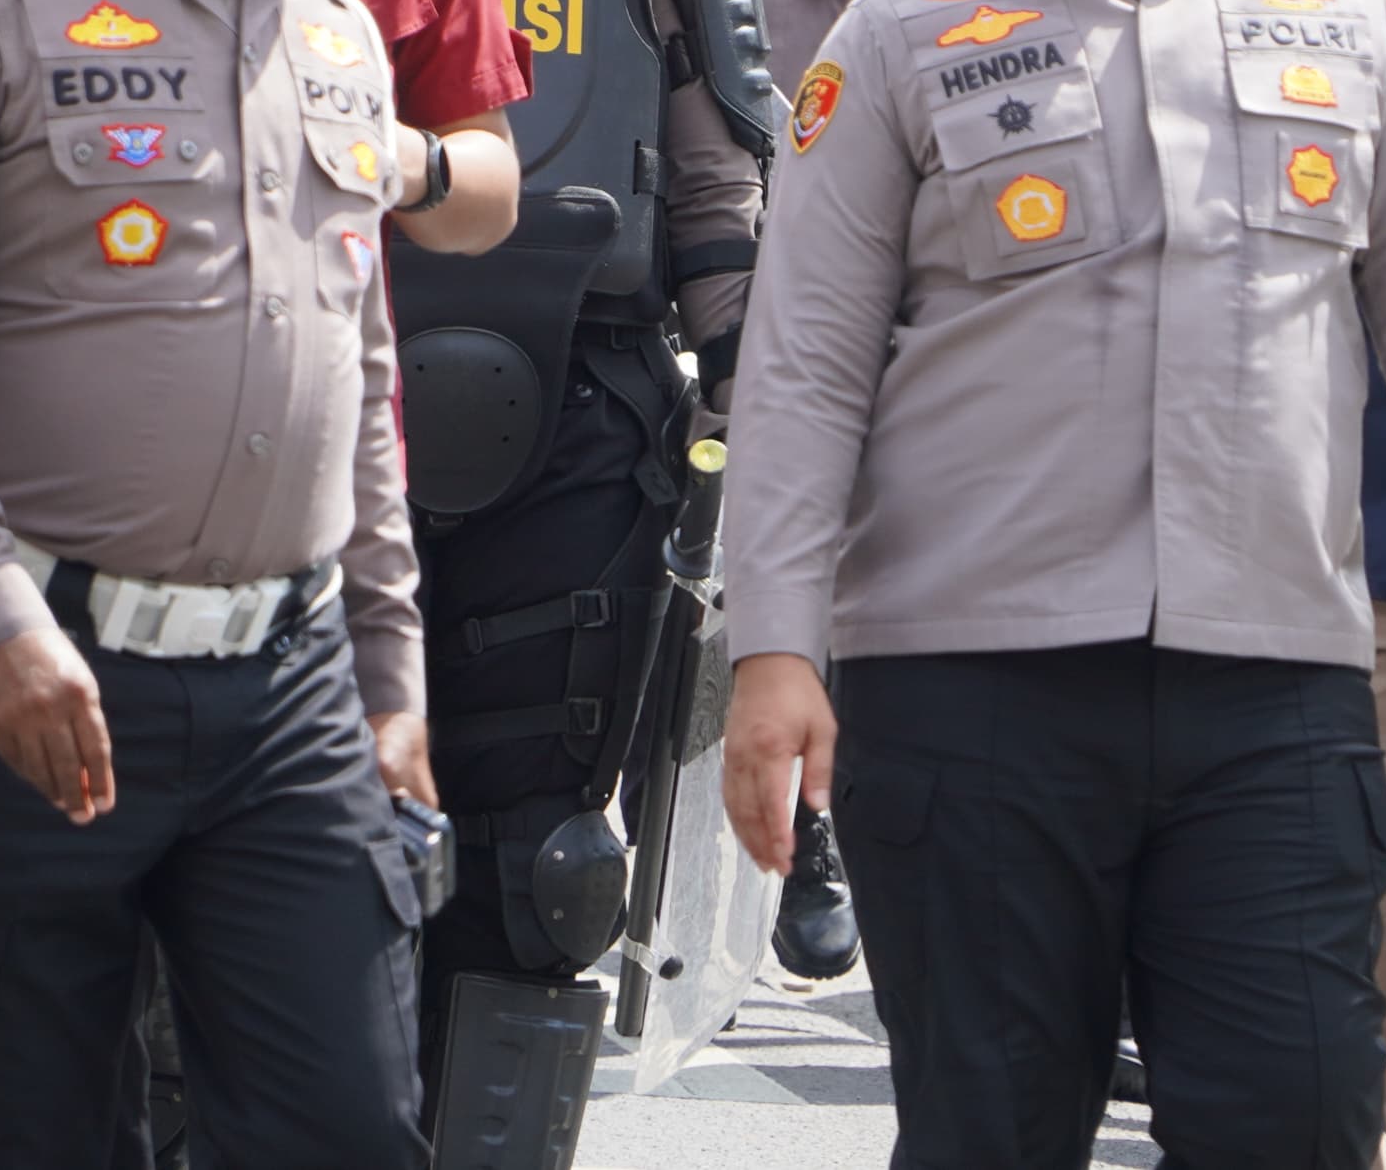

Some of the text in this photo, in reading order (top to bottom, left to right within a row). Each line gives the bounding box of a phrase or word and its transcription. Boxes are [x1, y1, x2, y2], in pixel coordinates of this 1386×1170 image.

[1240, 19, 1356, 51] POLRI
[52, 65, 188, 107] EDDY
[939, 41, 1065, 98] HENDRA
